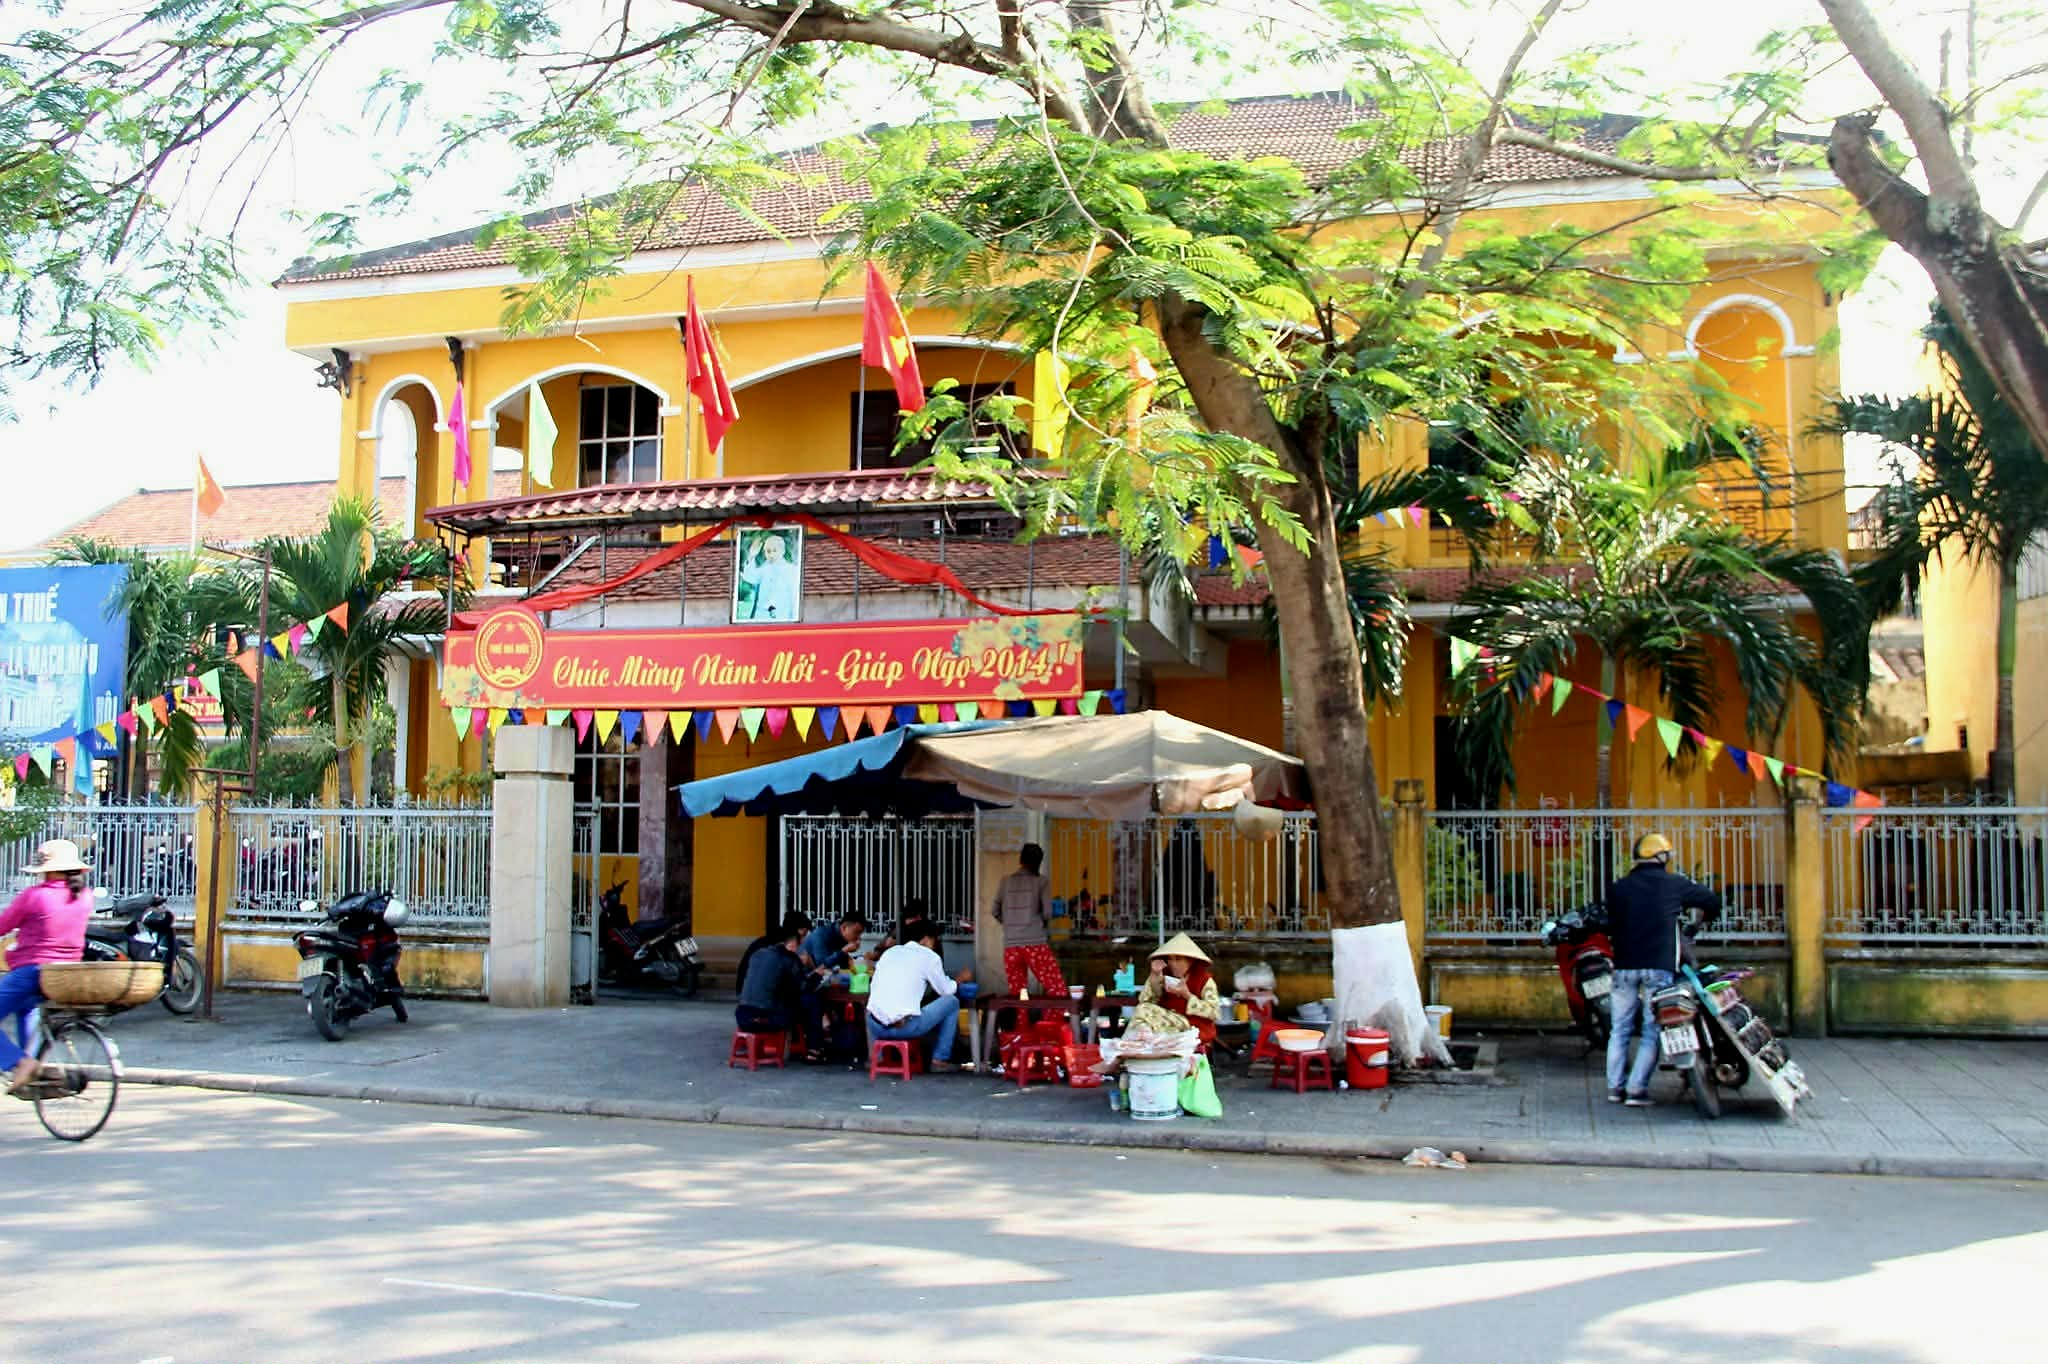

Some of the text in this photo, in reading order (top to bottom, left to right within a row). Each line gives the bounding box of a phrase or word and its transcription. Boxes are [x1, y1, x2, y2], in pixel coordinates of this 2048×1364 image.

[13, 582, 60, 624] THUẾ
[553, 655, 609, 688] Chúc
[613, 655, 685, 694] Mừng
[691, 653, 758, 686] Năm
[762, 651, 817, 684] Mới
[834, 648, 904, 691] Giáp
[911, 646, 971, 688] Ngọ
